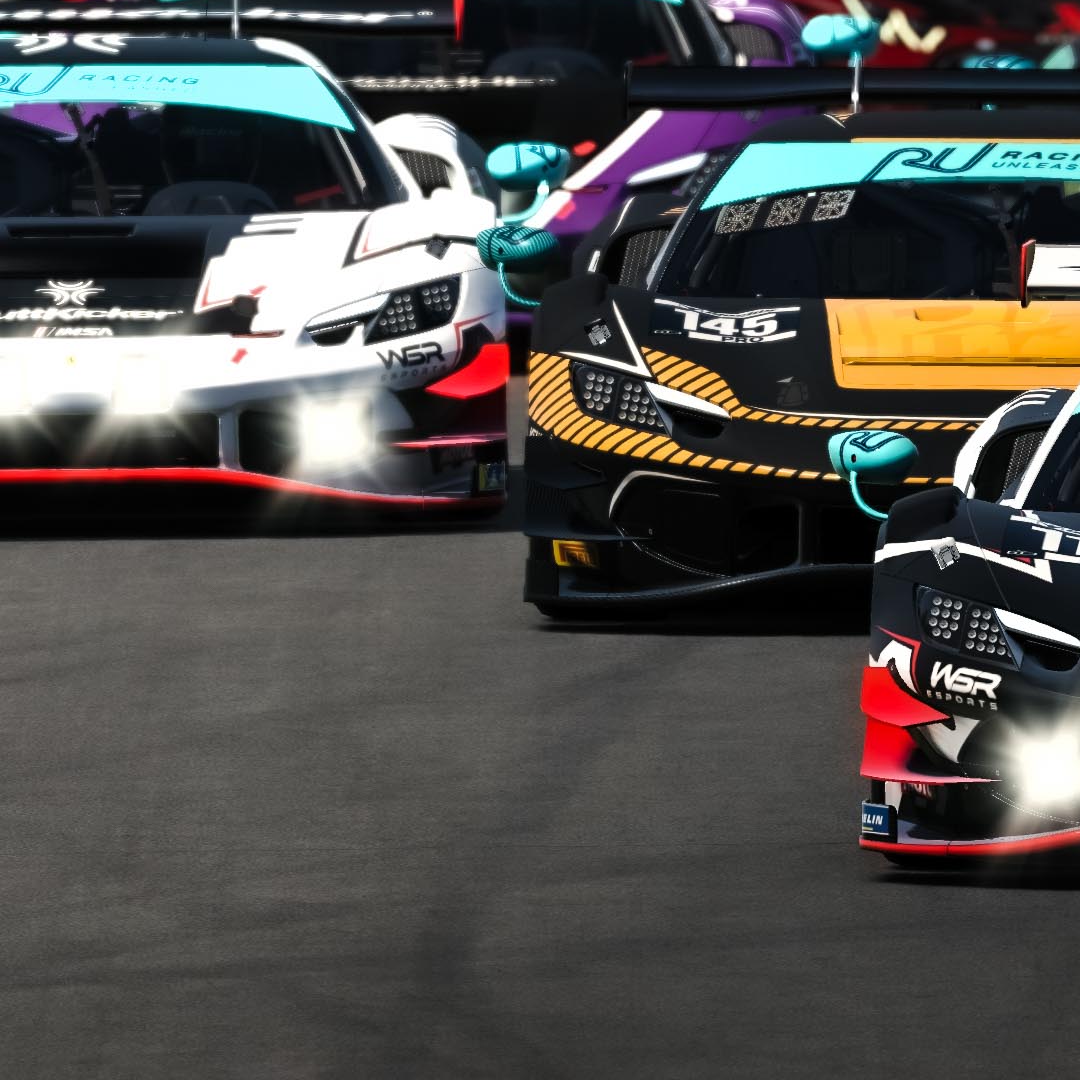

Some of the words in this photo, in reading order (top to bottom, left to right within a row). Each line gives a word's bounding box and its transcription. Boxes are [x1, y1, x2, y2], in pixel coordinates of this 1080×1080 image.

[674, 308, 778, 337] 145
[721, 335, 764, 344] PRO
[376, 341, 446, 370] WSR
[930, 661, 1002, 699] WSR
[926, 689, 998, 711] ESPORTS
